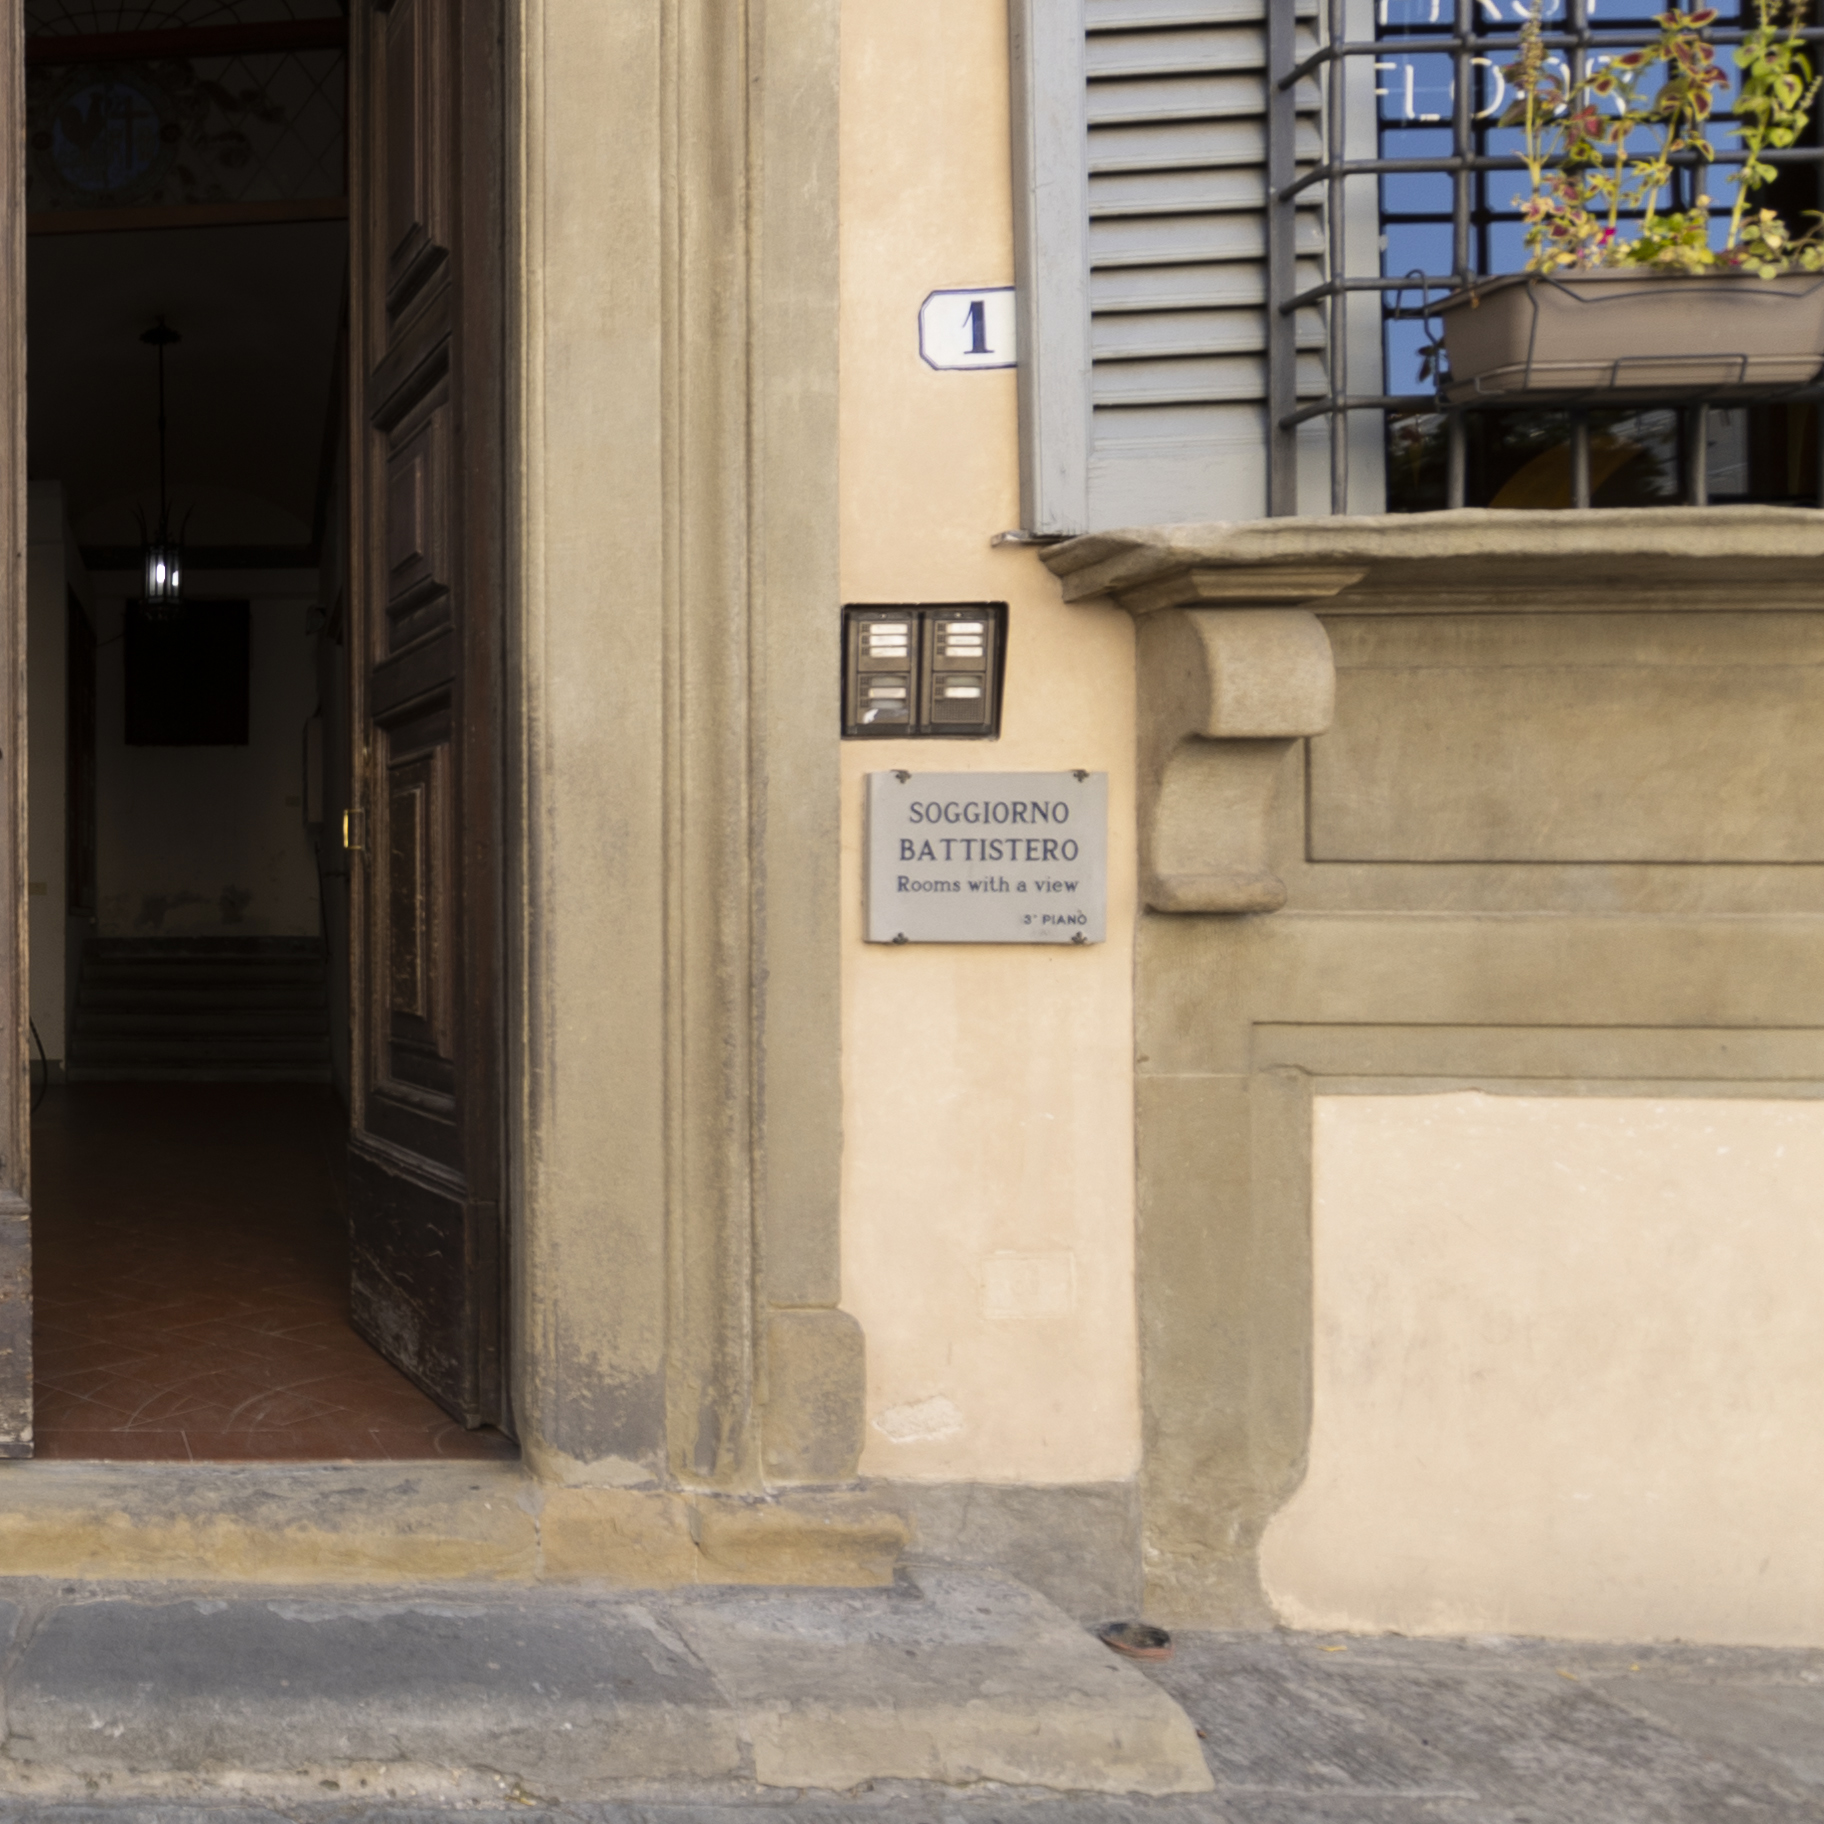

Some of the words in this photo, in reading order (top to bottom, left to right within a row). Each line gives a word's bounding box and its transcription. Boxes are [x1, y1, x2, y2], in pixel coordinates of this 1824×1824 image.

[962, 299, 996, 355] 1
[908, 800, 1070, 825] SOGGIORNO
[898, 838, 1080, 862] BATTISTERO
[896, 874, 962, 893] Rooms
[967, 875, 1012, 893] with
[1016, 880, 1028, 893] a
[1035, 877, 1080, 893] view
[1041, 914, 1088, 926] PIANO
